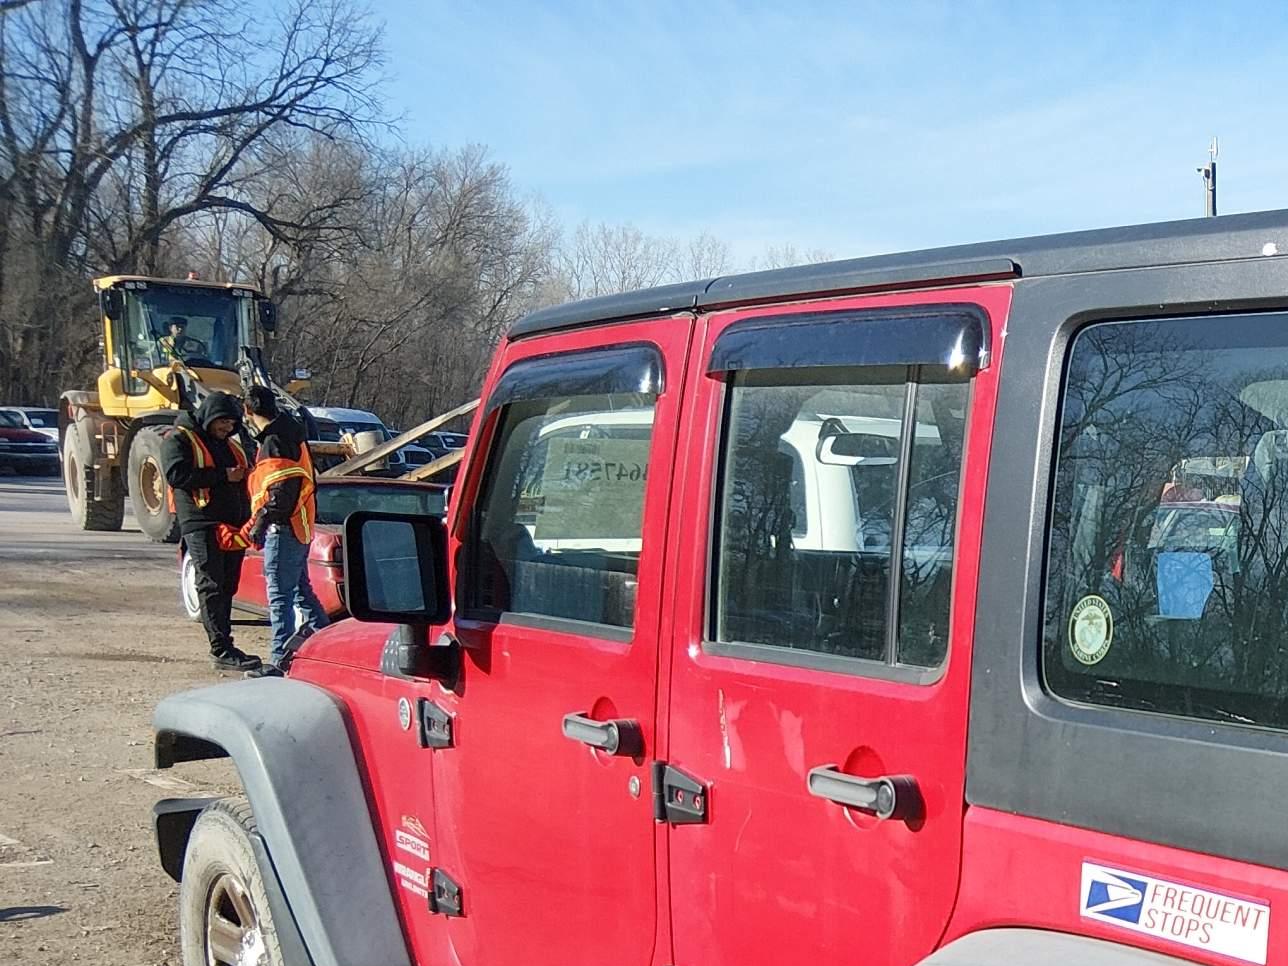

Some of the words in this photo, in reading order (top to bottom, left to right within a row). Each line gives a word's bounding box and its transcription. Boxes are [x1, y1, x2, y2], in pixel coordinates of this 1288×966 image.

[398, 835, 430, 856] SPORT
[1151, 884, 1266, 930] FREQUENT
[1144, 908, 1214, 944] STOPS
